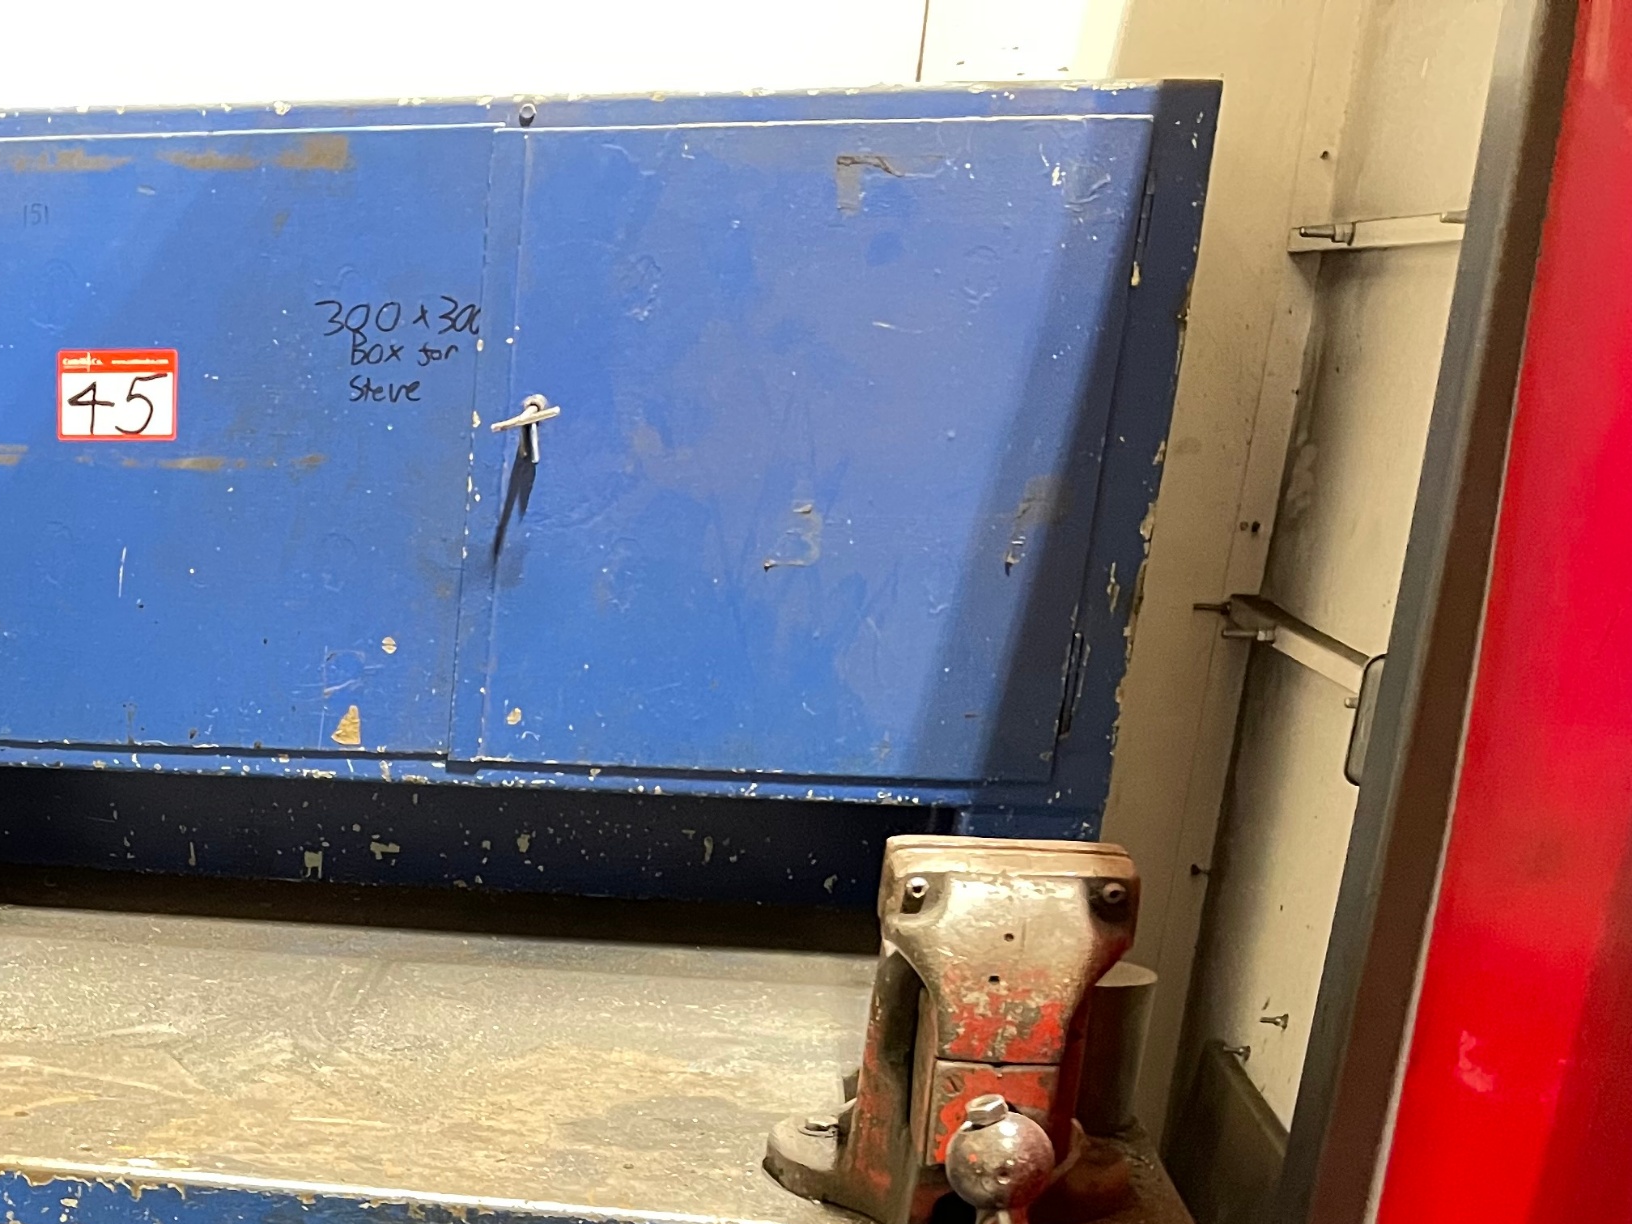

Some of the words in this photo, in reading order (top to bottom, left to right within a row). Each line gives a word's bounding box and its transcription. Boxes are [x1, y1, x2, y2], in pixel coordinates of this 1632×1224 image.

[23, 202, 50, 228] 151
[313, 299, 402, 337] 300
[66, 372, 169, 435] 45
[348, 374, 422, 403] Steve
